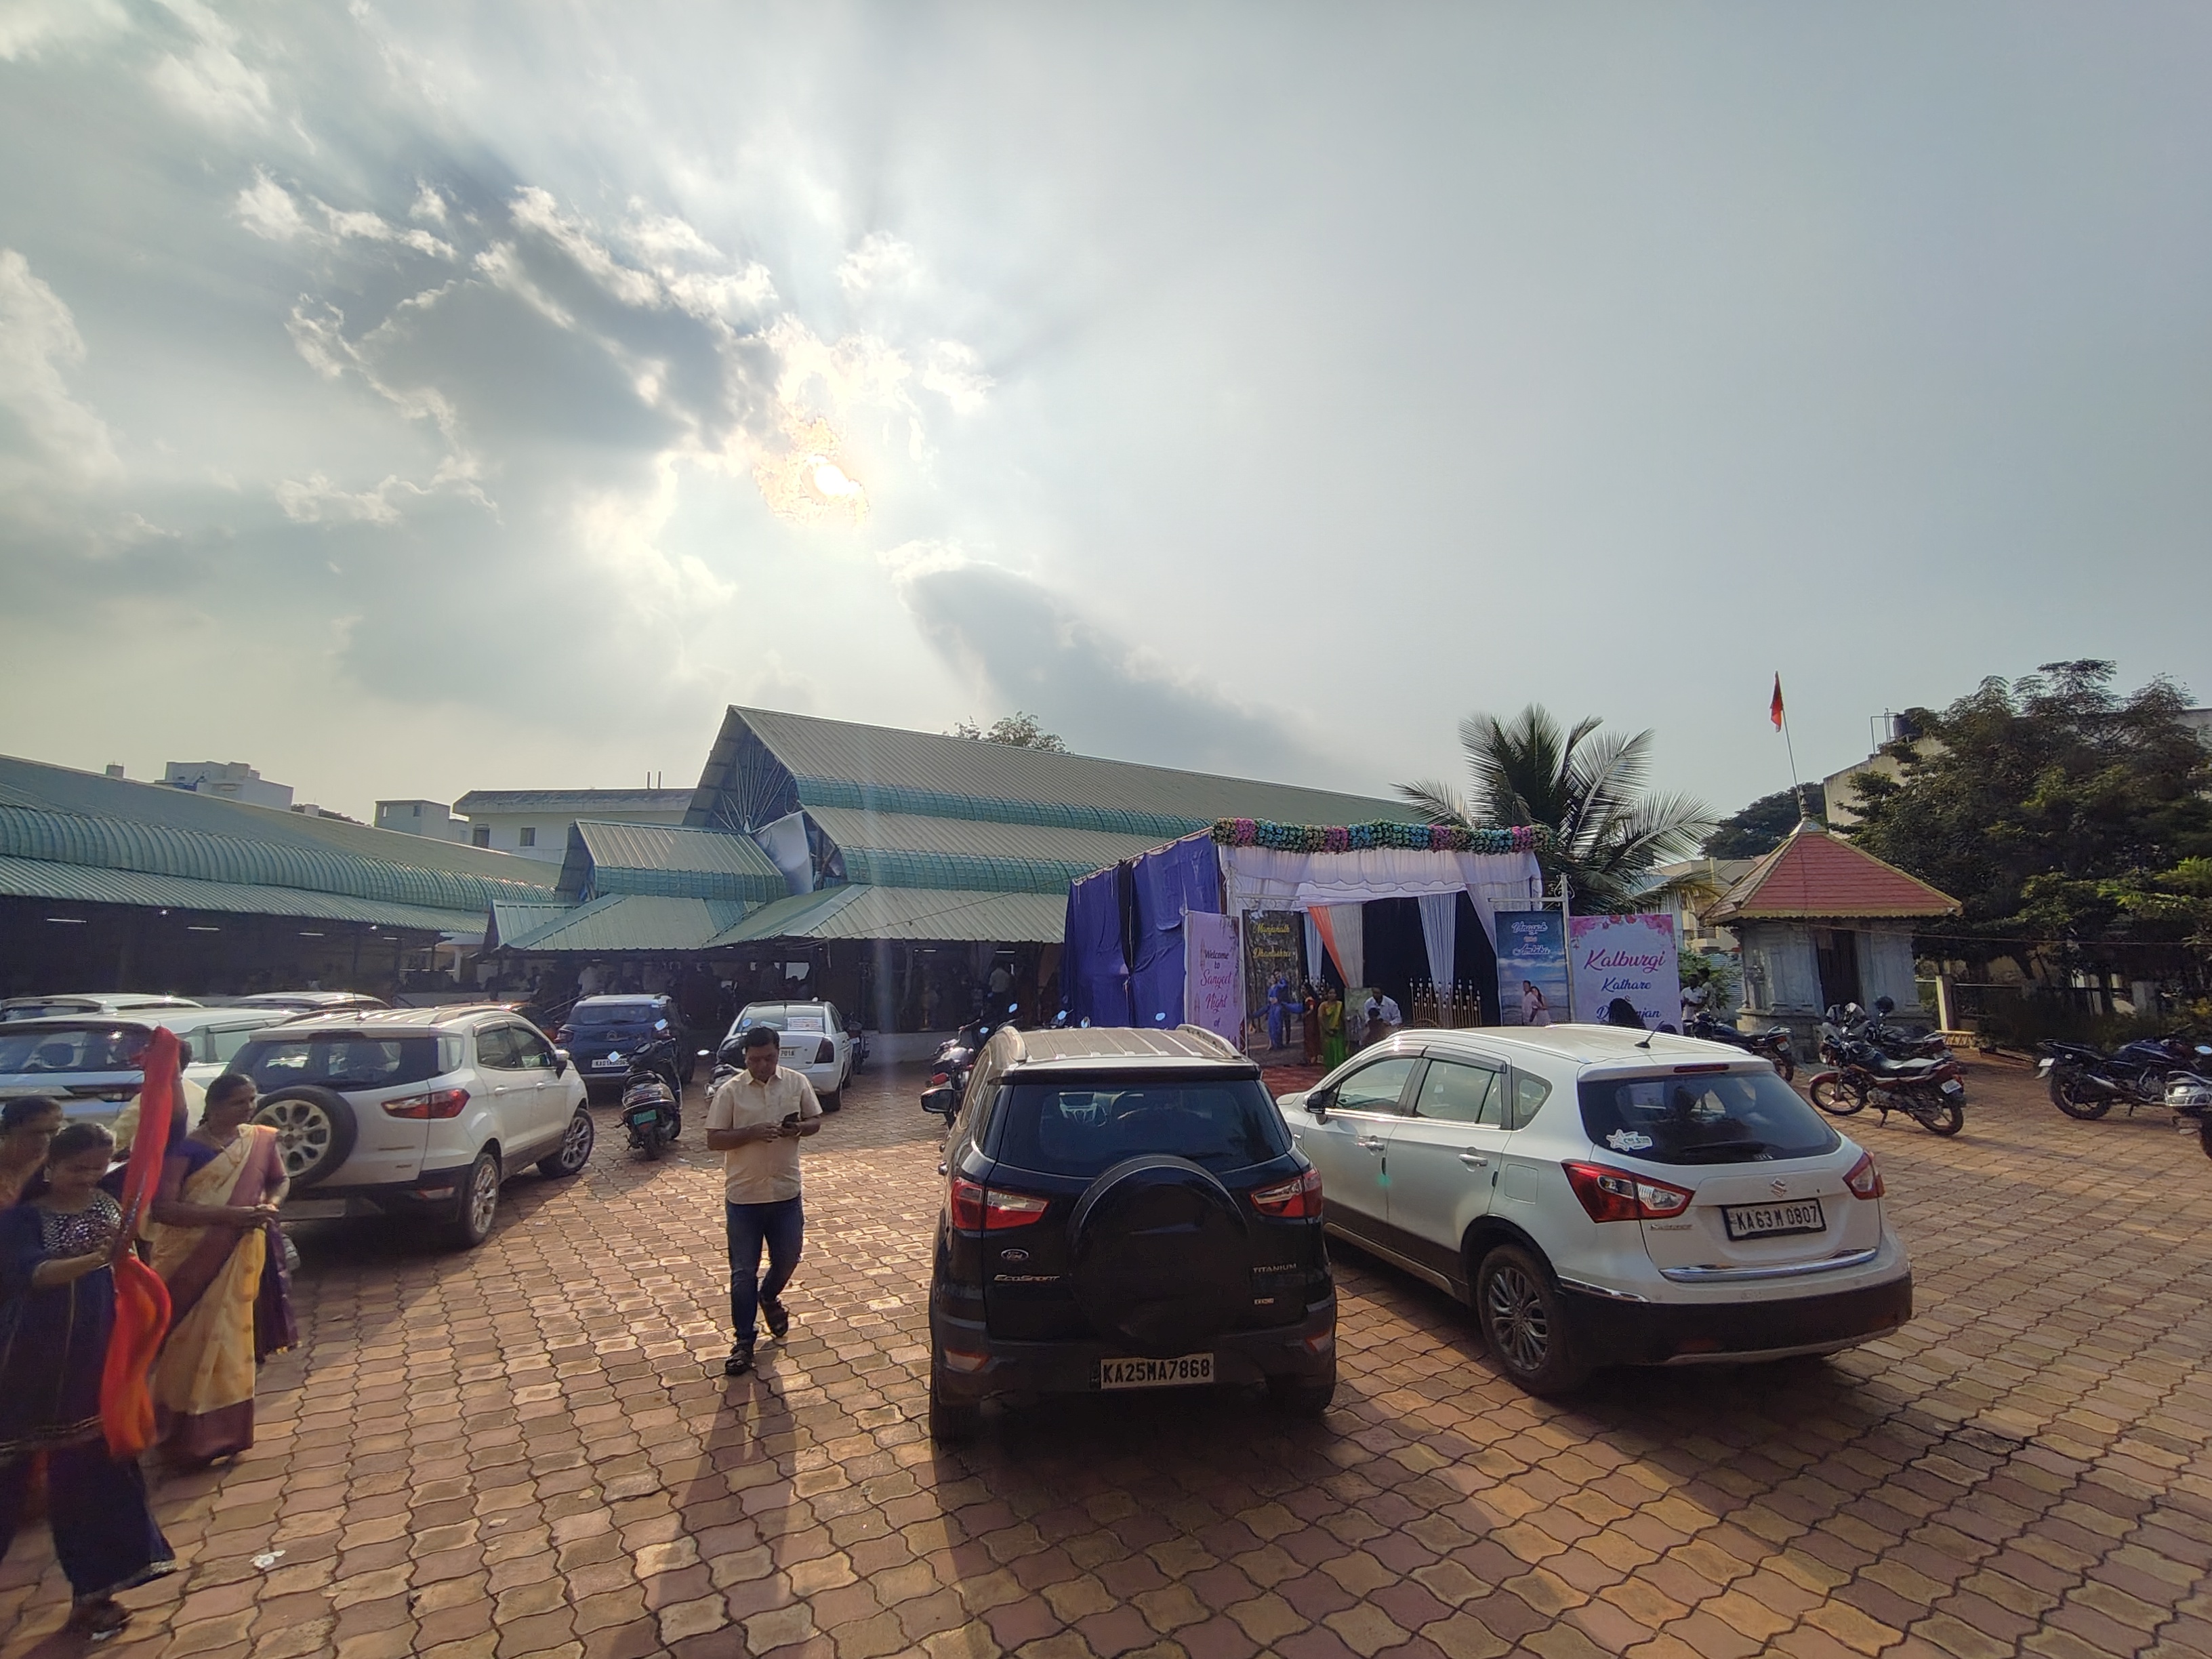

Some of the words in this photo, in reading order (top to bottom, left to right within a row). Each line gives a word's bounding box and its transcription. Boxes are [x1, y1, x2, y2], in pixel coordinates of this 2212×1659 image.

[1204, 949, 1229, 960] Welcome
[1584, 949, 1666, 973] Kalburgi
[1214, 961, 1221, 970] to
[1200, 968, 1232, 989] Sangeet
[1205, 993, 1228, 1013] Night
[1214, 1018, 1221, 1028] of
[1253, 1263, 1296, 1273] TITANIUM
[1103, 1359, 1210, 1383] KA25MA7868
